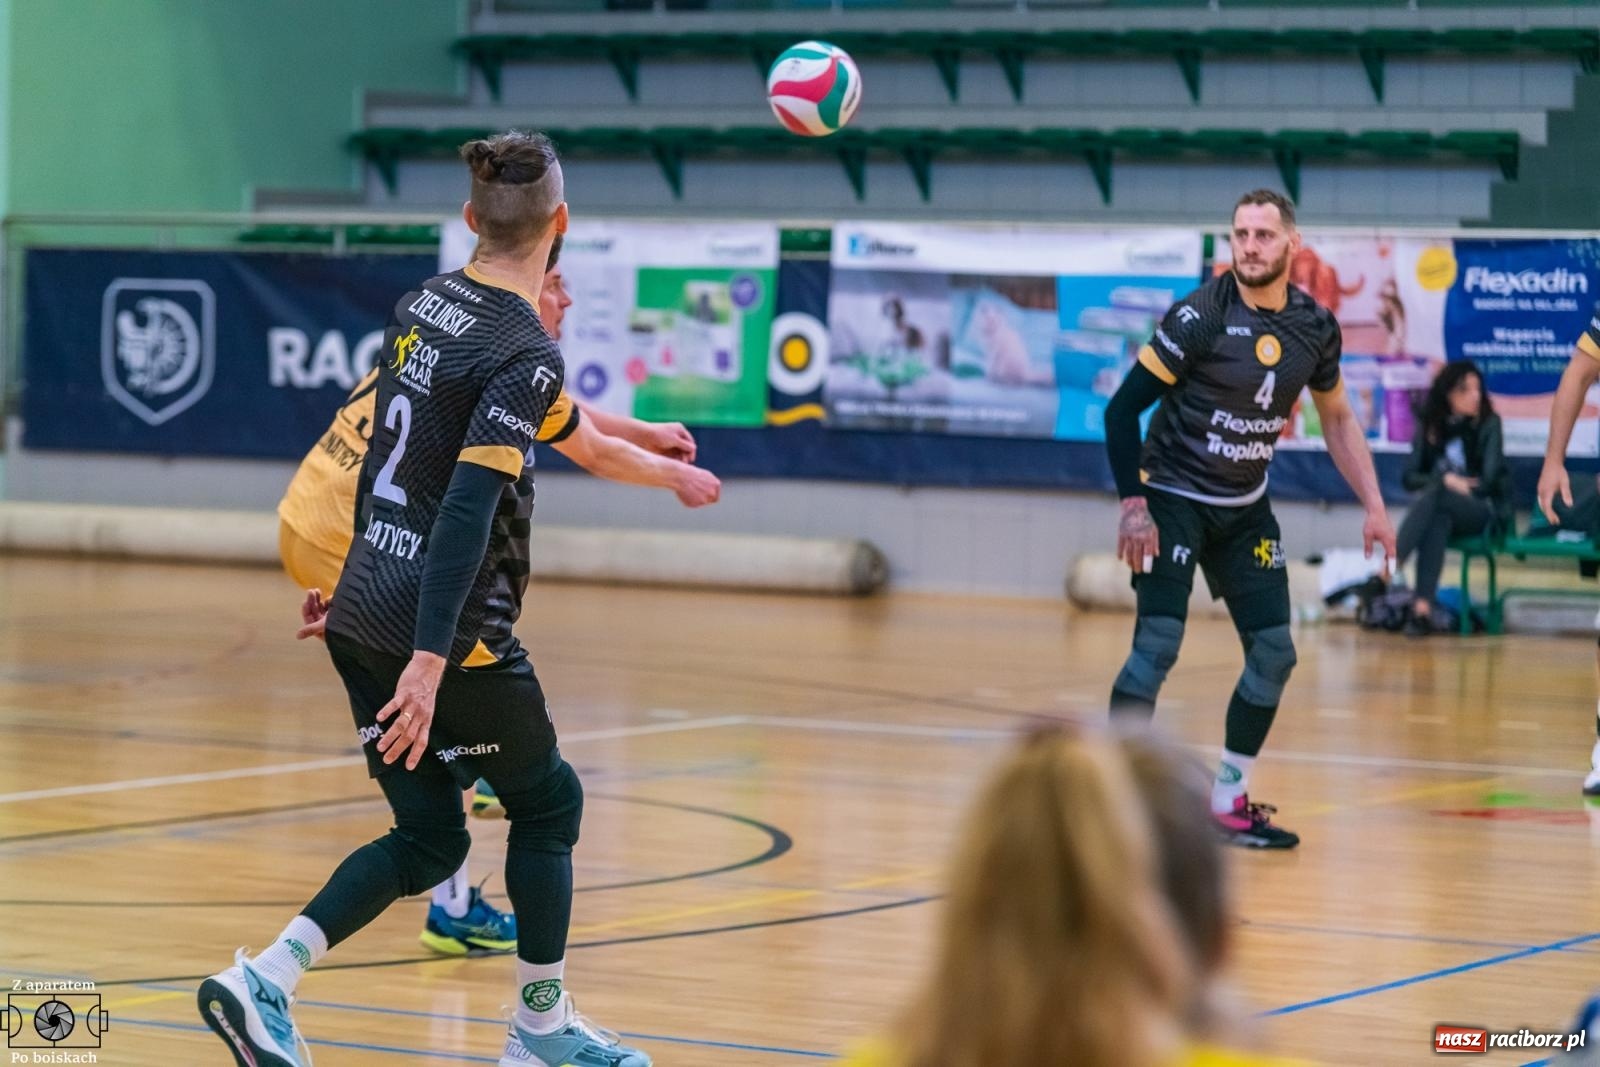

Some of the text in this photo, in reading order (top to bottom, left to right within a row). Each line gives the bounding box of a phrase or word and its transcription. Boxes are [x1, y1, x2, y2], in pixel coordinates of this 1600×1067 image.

[1464, 266, 1588, 296] Flexadin
[408, 289, 477, 337] ZIELIŃSKI
[411, 338, 439, 367] ZOO
[400, 359, 432, 387] MAR
[1254, 370, 1275, 410] 4
[373, 394, 412, 507] 2
